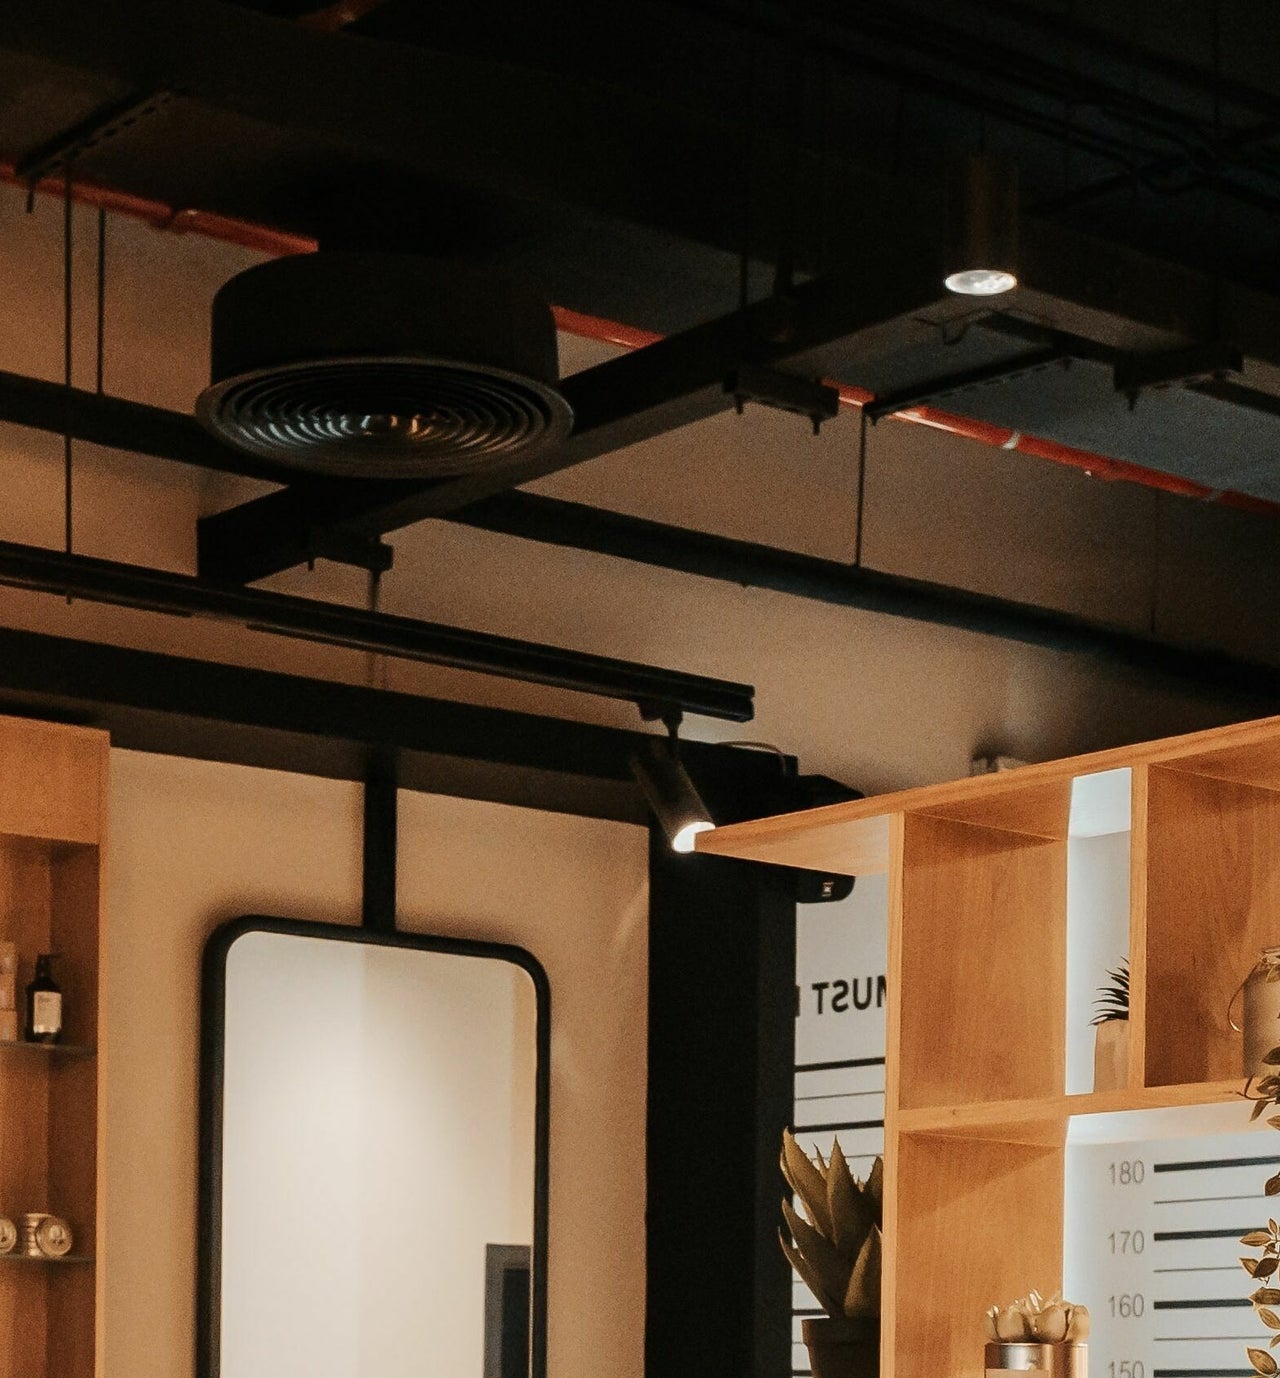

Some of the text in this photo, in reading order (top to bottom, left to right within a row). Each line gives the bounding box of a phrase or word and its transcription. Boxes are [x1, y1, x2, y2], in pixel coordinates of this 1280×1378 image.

[1108, 1159, 1145, 1185] 180
[1107, 1229, 1145, 1255] 170
[1107, 1293, 1145, 1318] 160
